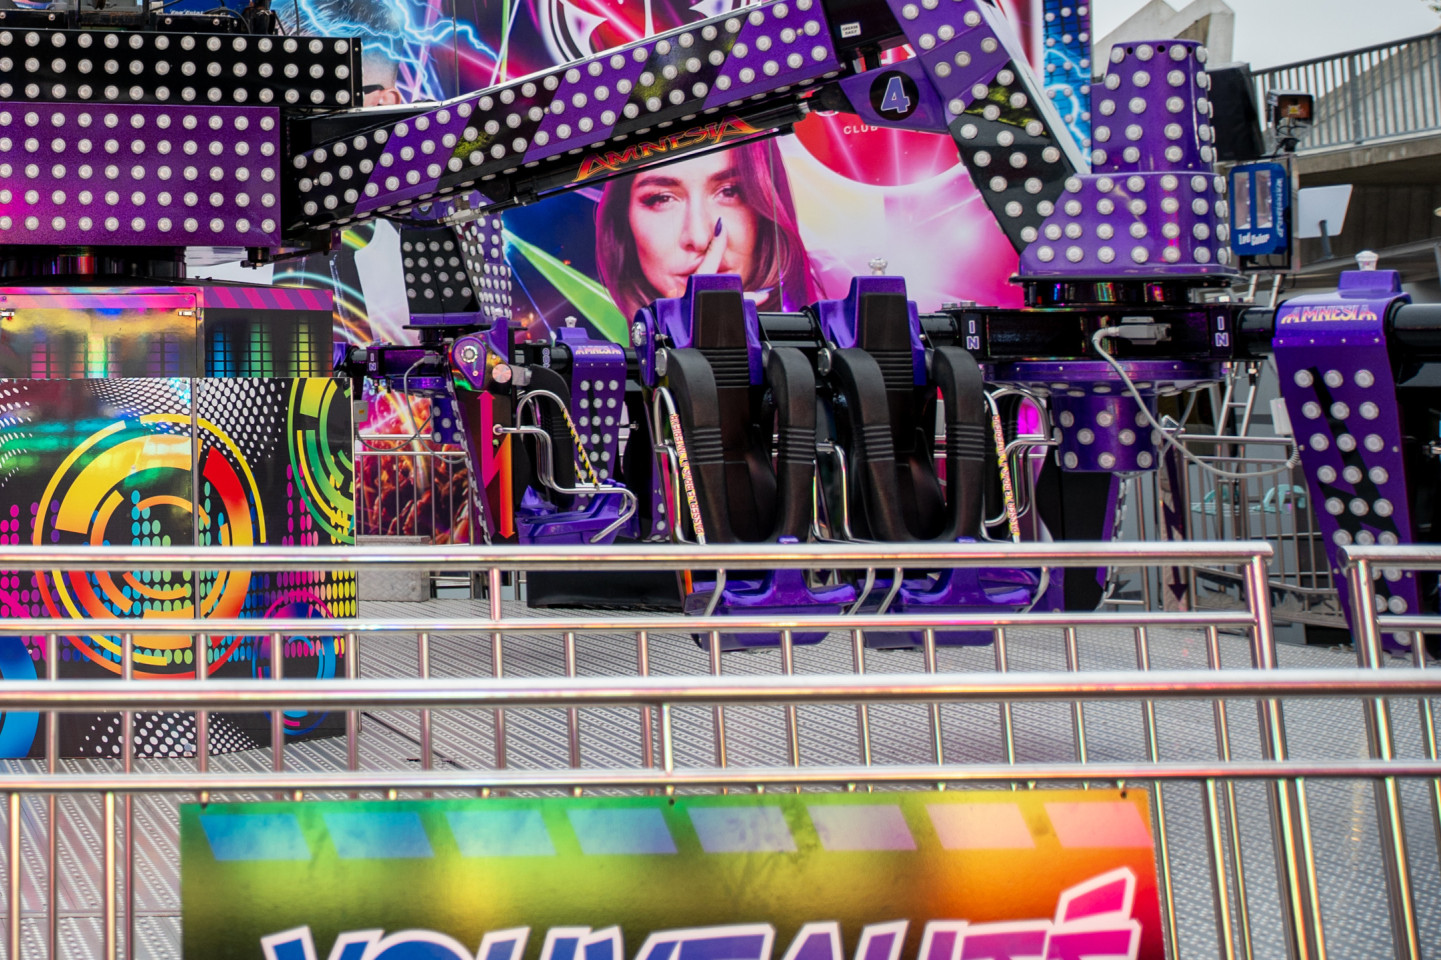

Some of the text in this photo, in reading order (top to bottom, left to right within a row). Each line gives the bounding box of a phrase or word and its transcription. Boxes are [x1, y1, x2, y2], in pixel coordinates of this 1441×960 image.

[881, 76, 910, 113] 4
[572, 114, 764, 182] AMNESIA
[1281, 304, 1377, 324] AMNESIA
[967, 320, 980, 350] IN
[1215, 315, 1229, 347] IN
